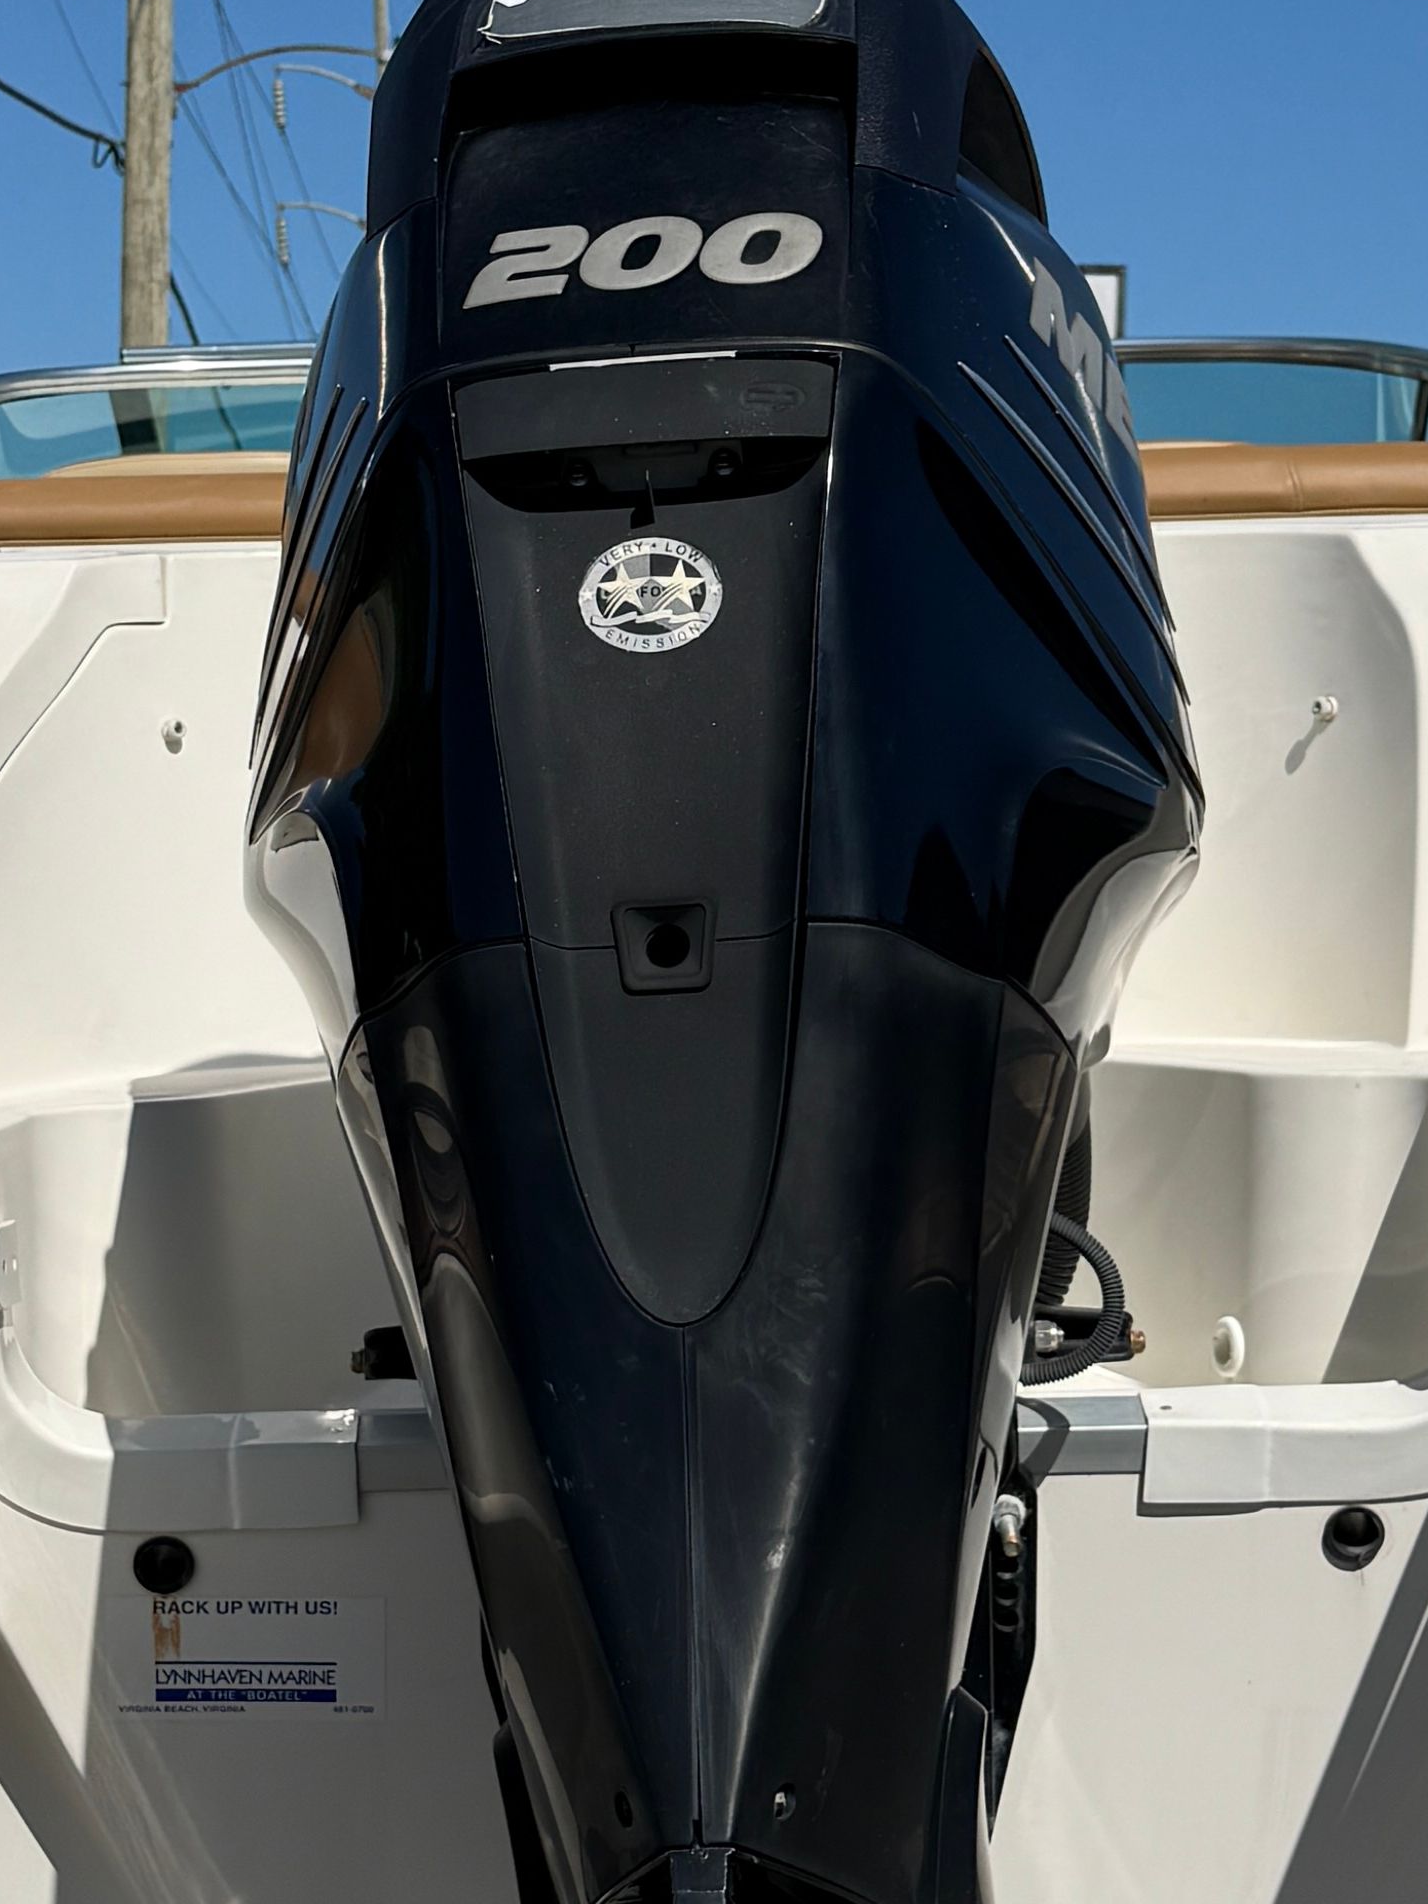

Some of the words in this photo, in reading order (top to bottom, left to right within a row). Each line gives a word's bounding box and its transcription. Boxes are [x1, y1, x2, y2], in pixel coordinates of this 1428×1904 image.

[461, 211, 824, 310] 200
[599, 541, 644, 568] VERY
[665, 541, 704, 564] LOW
[605, 622, 702, 649] EMISSION
[153, 1600, 210, 1615] RACK
[216, 1600, 244, 1615] UP
[248, 1600, 299, 1615] WITH
[304, 1600, 339, 1616] US!
[155, 1668, 263, 1685] LYNNHAVEN
[267, 1668, 336, 1686] MARINE
[187, 1689, 204, 1701] AT
[209, 1689, 237, 1701] THE
